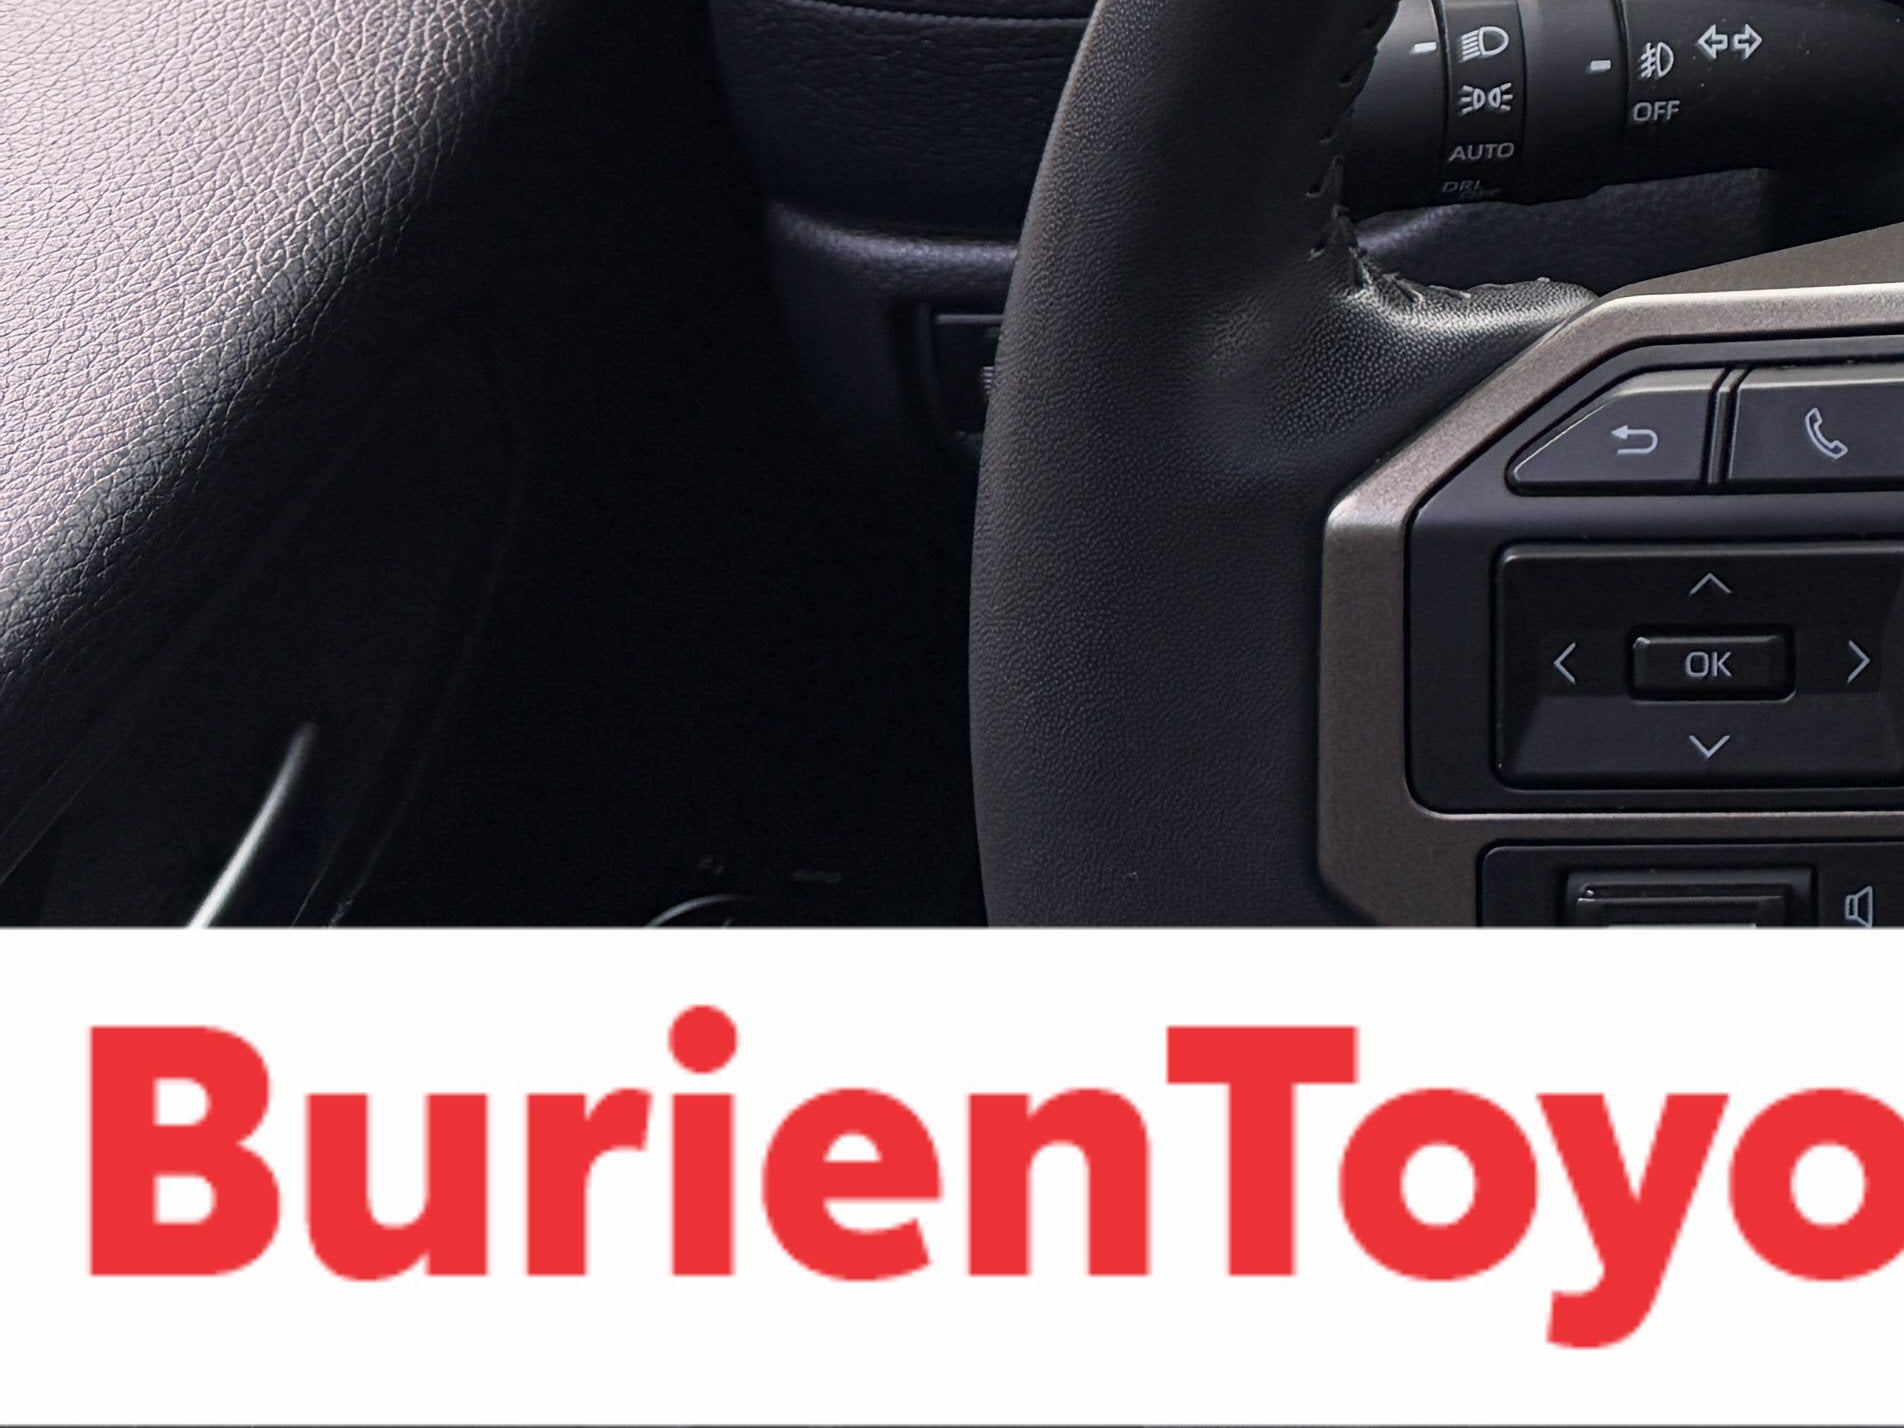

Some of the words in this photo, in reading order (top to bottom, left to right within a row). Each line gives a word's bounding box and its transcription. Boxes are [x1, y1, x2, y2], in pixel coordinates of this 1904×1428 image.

[1633, 101, 1680, 121] OFF
[1449, 143, 1514, 161] AUTO
[1686, 652, 1731, 677] OK
